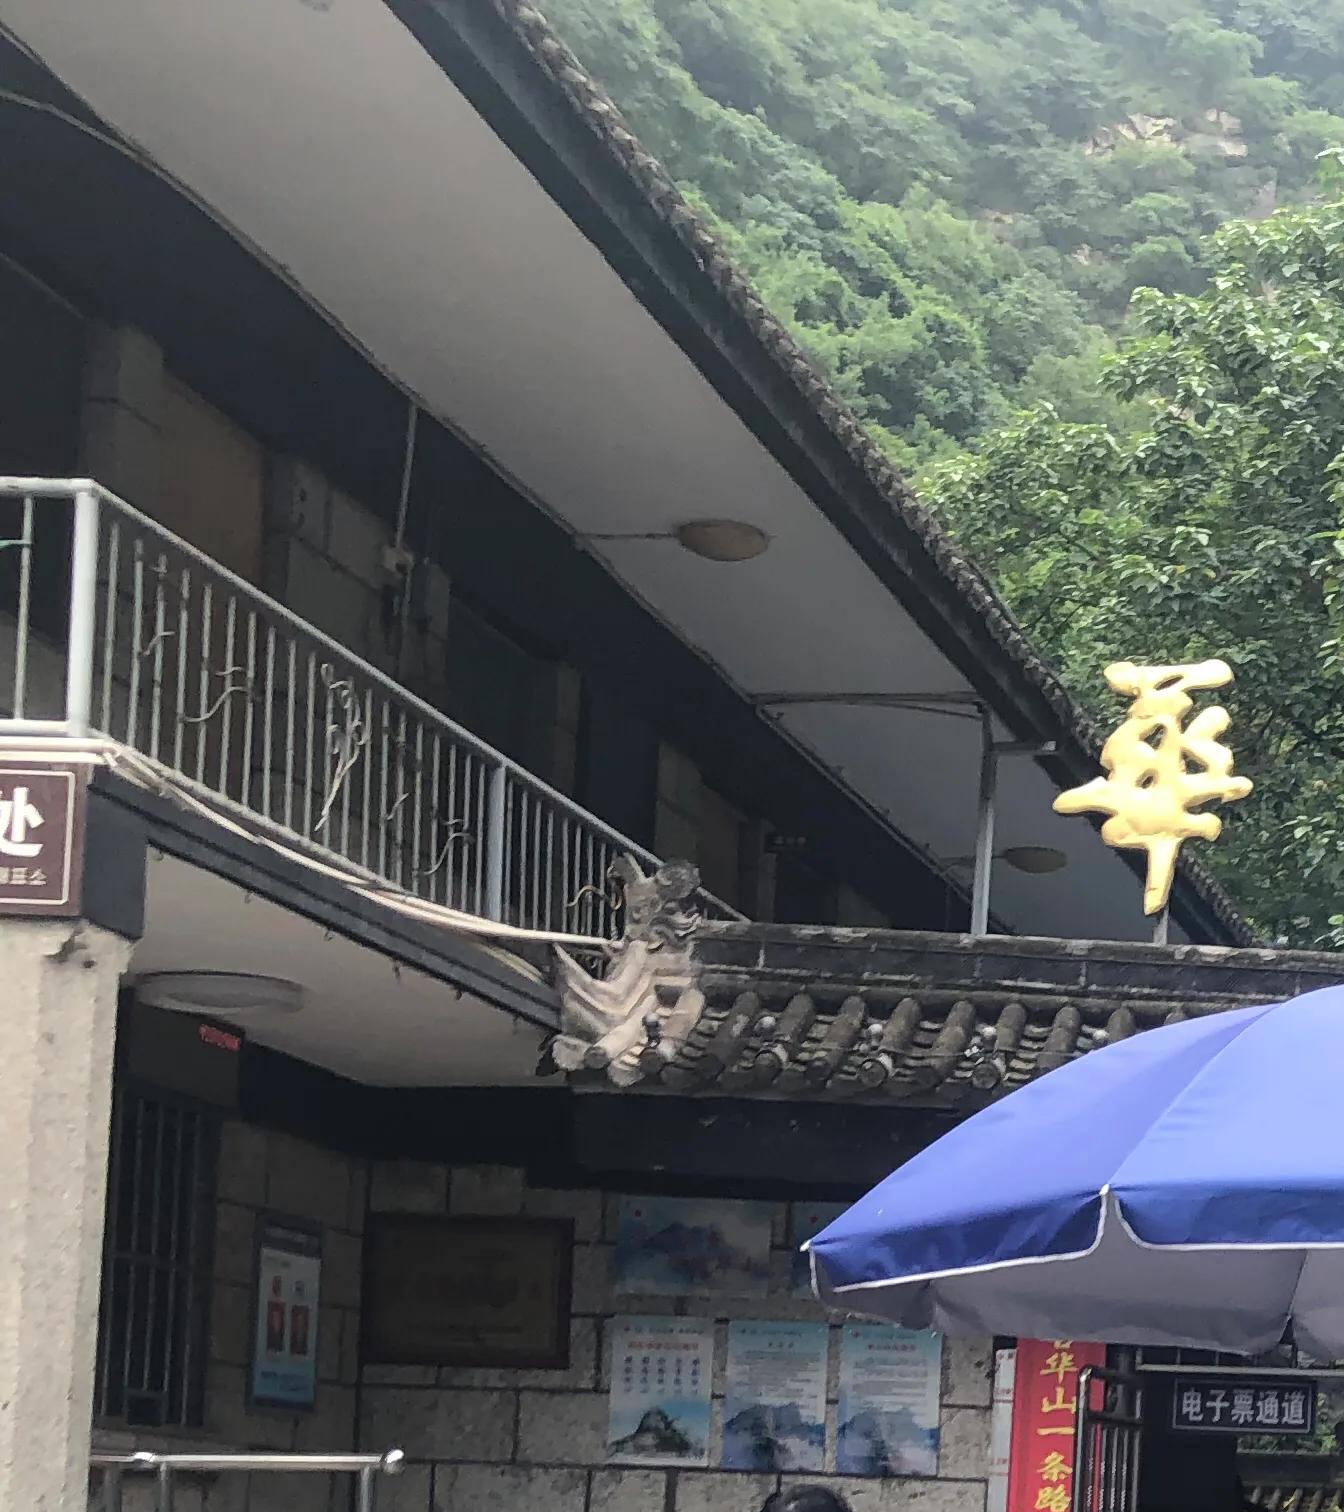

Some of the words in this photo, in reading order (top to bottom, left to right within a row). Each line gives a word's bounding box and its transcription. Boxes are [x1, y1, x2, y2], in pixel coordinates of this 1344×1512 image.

[1181, 1387, 1305, 1425] 电子票通道
